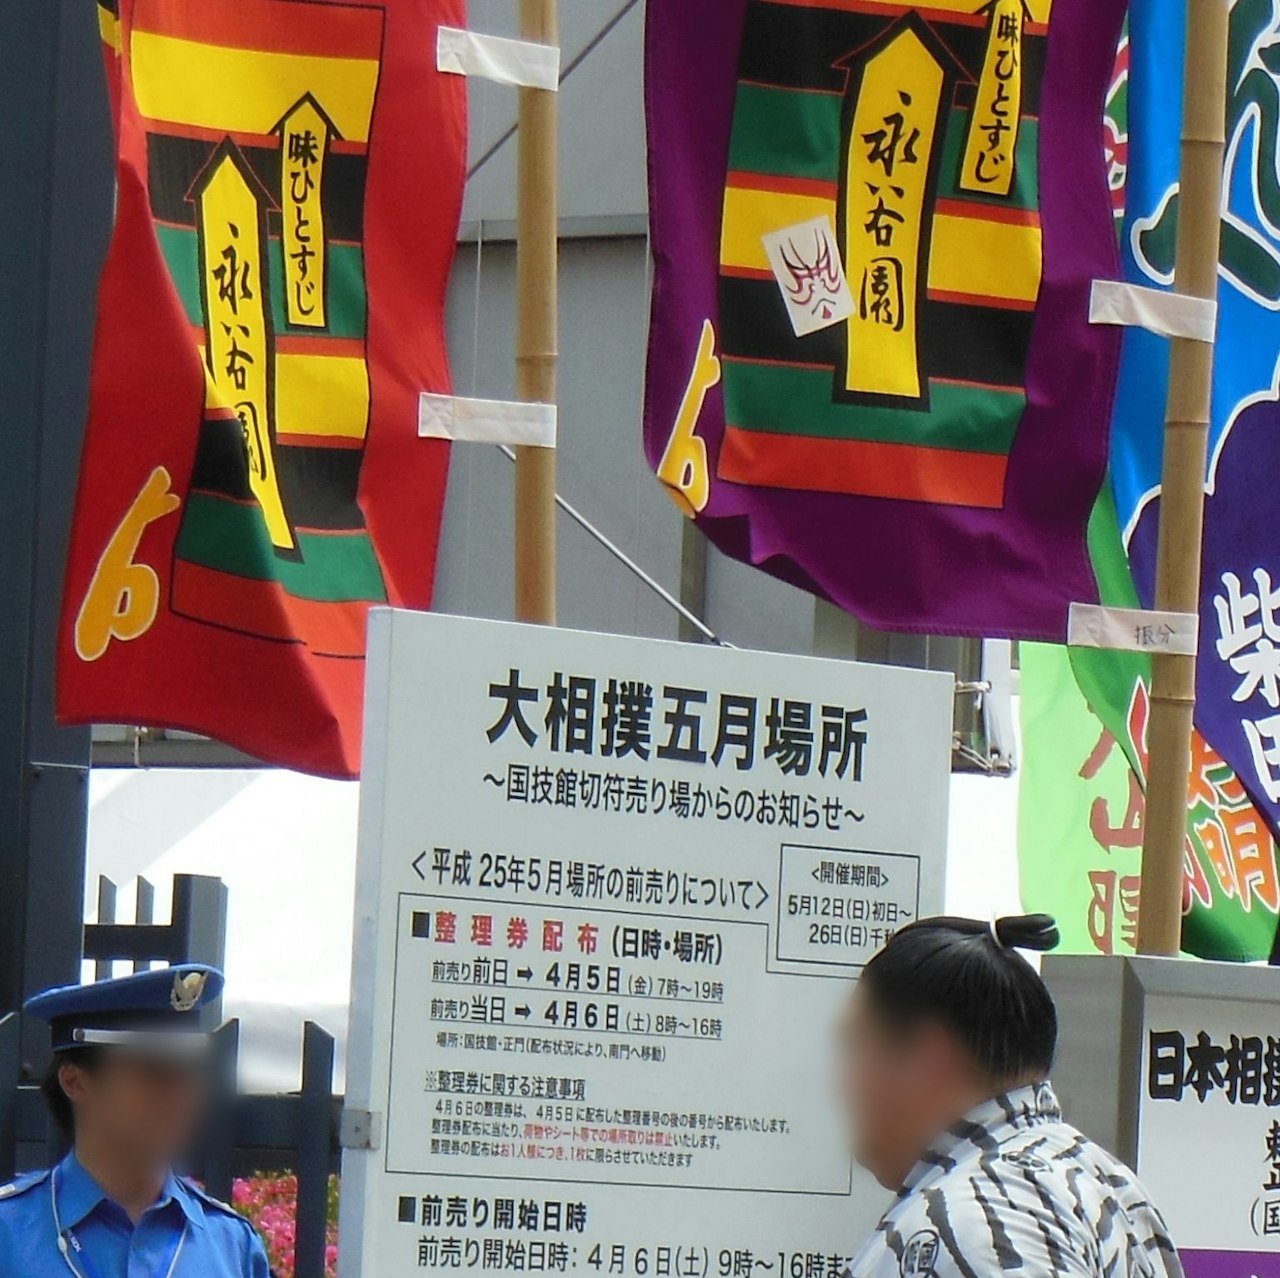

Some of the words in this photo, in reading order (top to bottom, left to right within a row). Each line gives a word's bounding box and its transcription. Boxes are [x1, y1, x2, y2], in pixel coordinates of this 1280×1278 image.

[975, 11, 1018, 184] 味ひとすじ
[288, 129, 318, 316] 味ひとすじ
[860, 90, 919, 332] 永谷園
[486, 668, 868, 782] 大相撲五月場所
[811, 861, 889, 888] <開催期間>
[788, 894, 912, 922] 5月12日(日)初日〜
[432, 956, 508, 986] 前売り前日
[430, 997, 506, 1023] 前売り当日
[421, 1195, 587, 1233] 前売り開始日時
